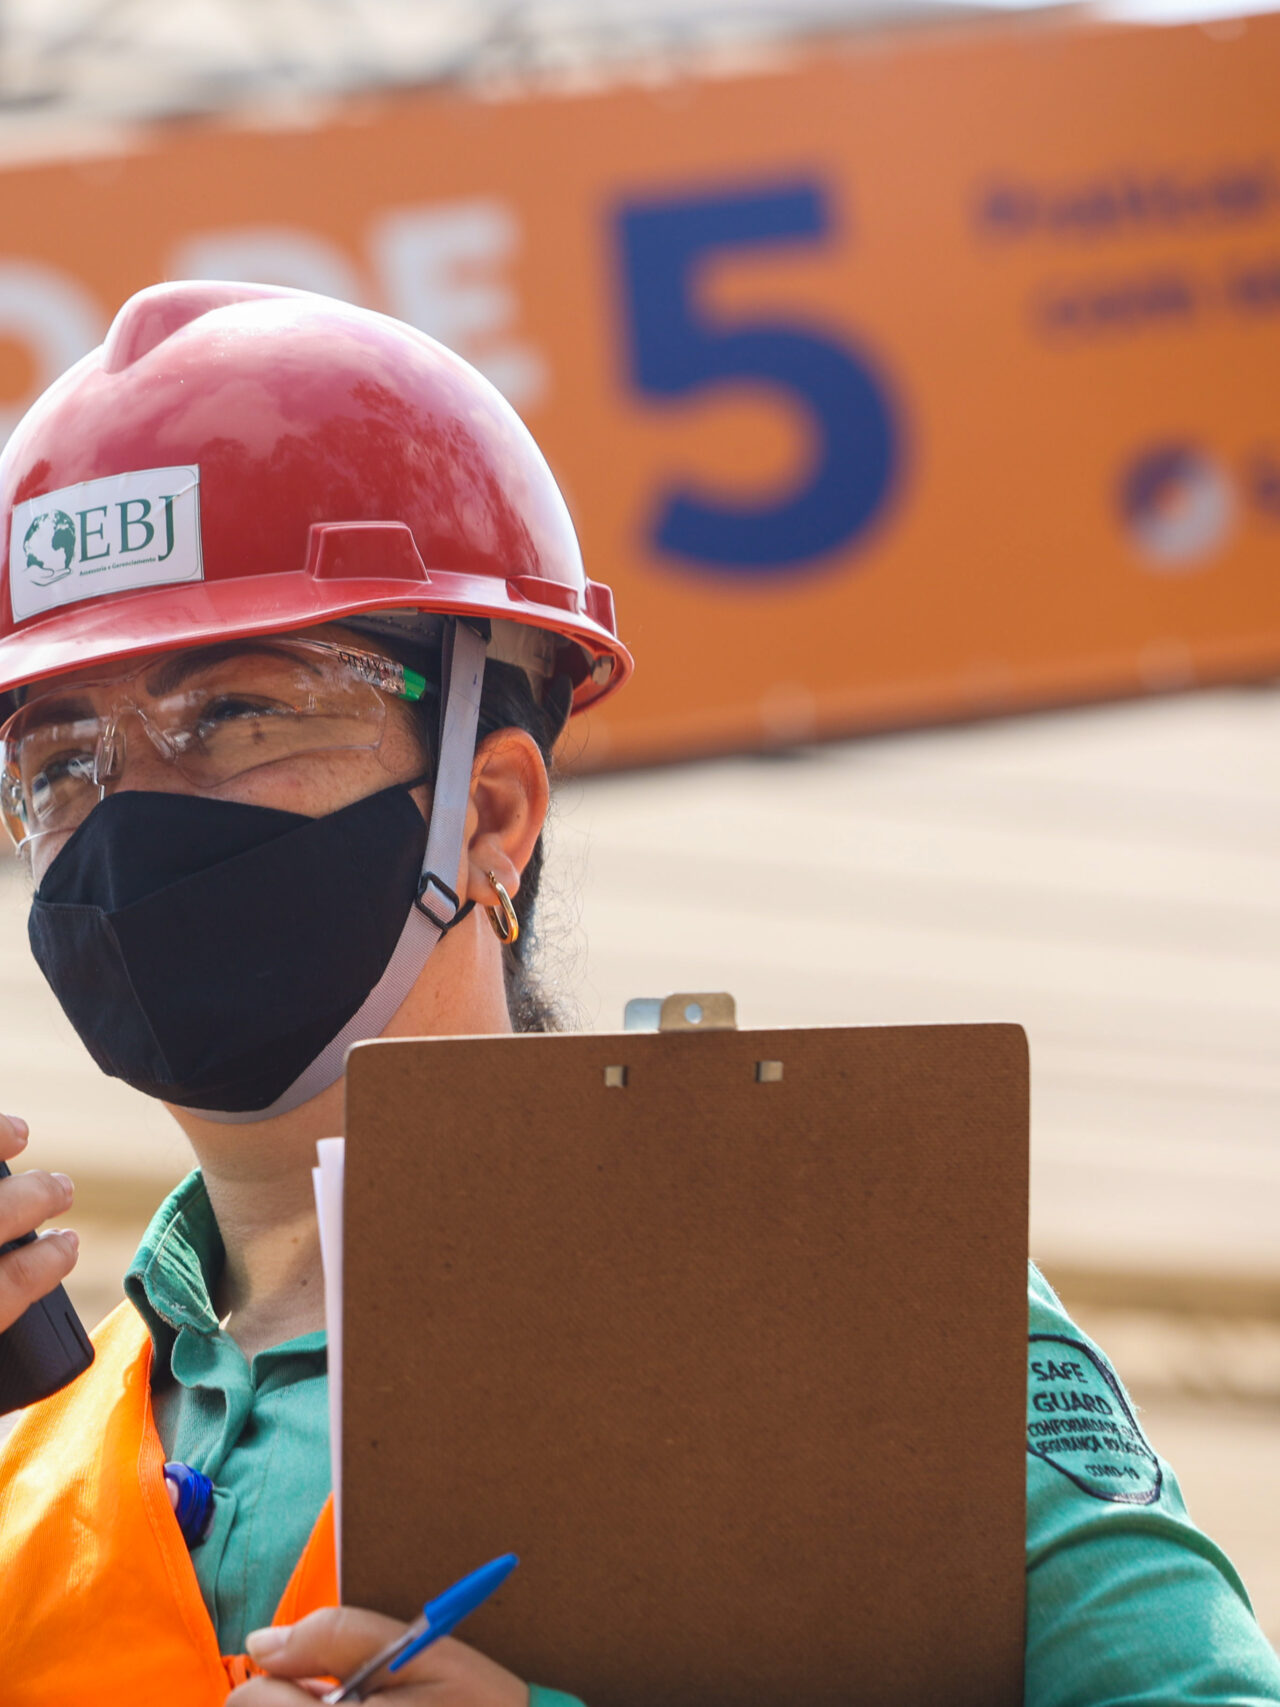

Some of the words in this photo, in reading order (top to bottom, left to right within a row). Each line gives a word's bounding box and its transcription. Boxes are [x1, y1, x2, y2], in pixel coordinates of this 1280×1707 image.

[609, 174, 904, 578] 5
[75, 494, 180, 563] EBJ
[1031, 1359, 1088, 1383] SAFE
[1032, 1391, 1113, 1415] GUARD
